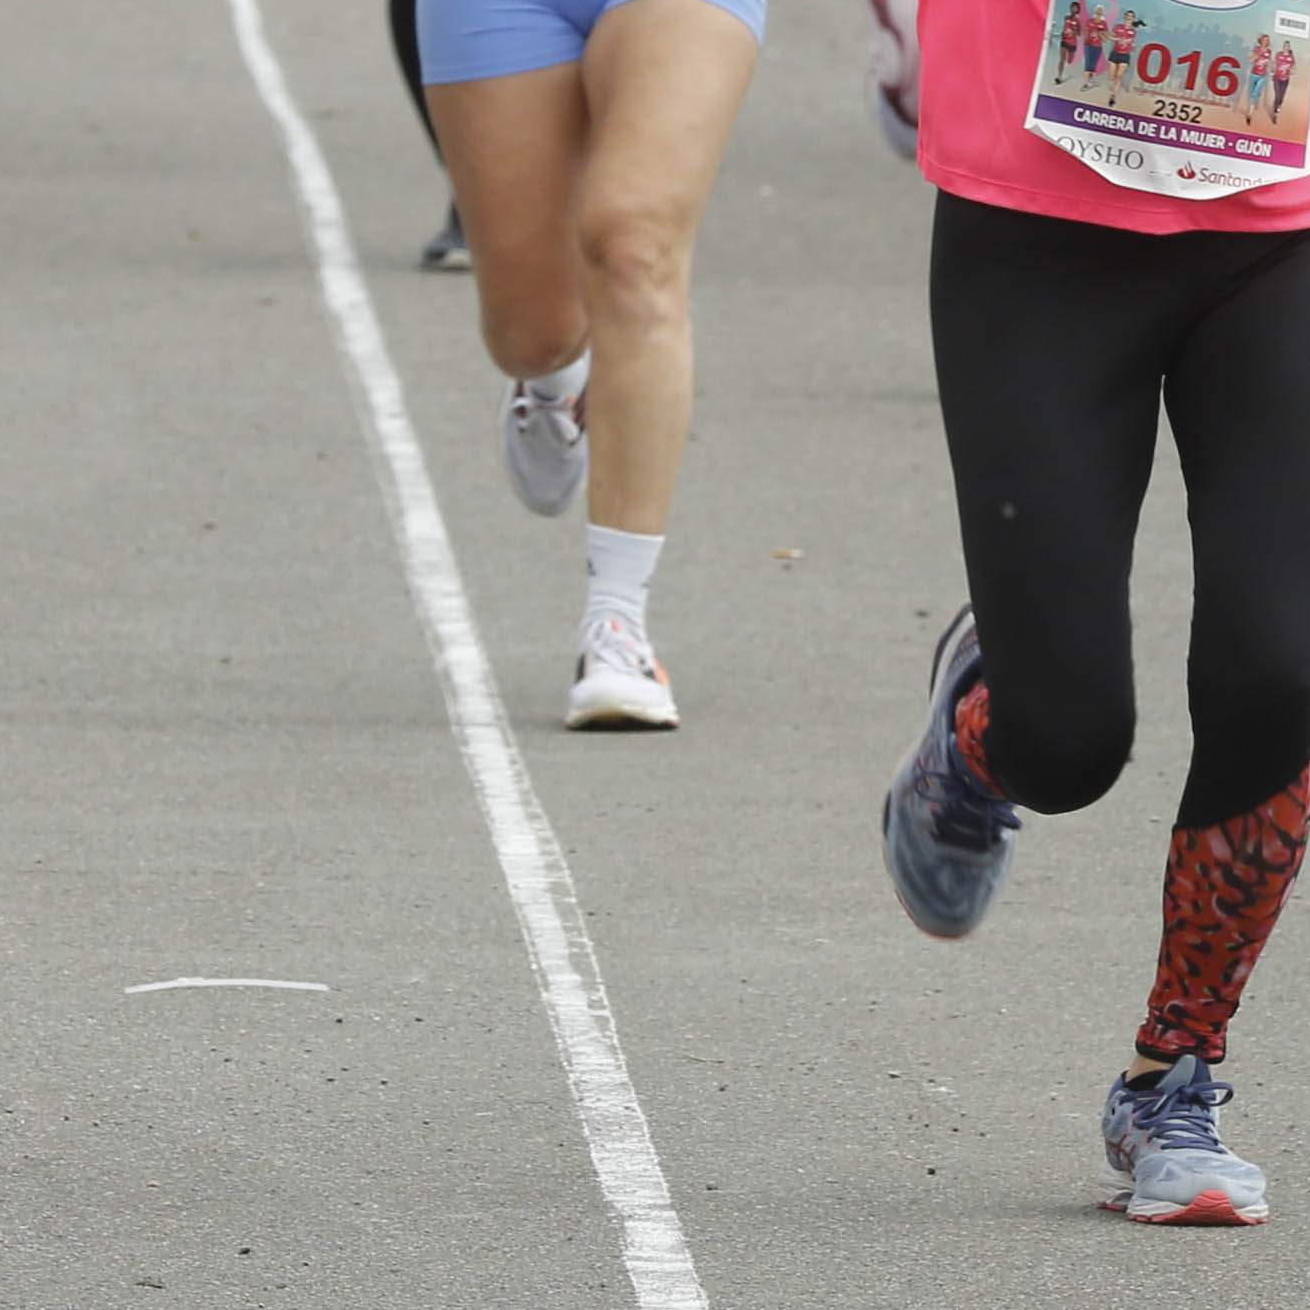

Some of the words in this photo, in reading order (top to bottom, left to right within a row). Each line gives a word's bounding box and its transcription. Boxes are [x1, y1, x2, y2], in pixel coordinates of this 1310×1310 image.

[1137, 42, 1241, 97] 016
[1074, 107, 1135, 133] CARRERA
[1138, 121, 1158, 137] DE
[1159, 125, 1177, 141] LA
[1180, 128, 1226, 150] MUJER
[1235, 138, 1272, 157] GIJÓN
[1153, 99, 1203, 124] 2352
[1057, 136, 1144, 170] OYSHO
